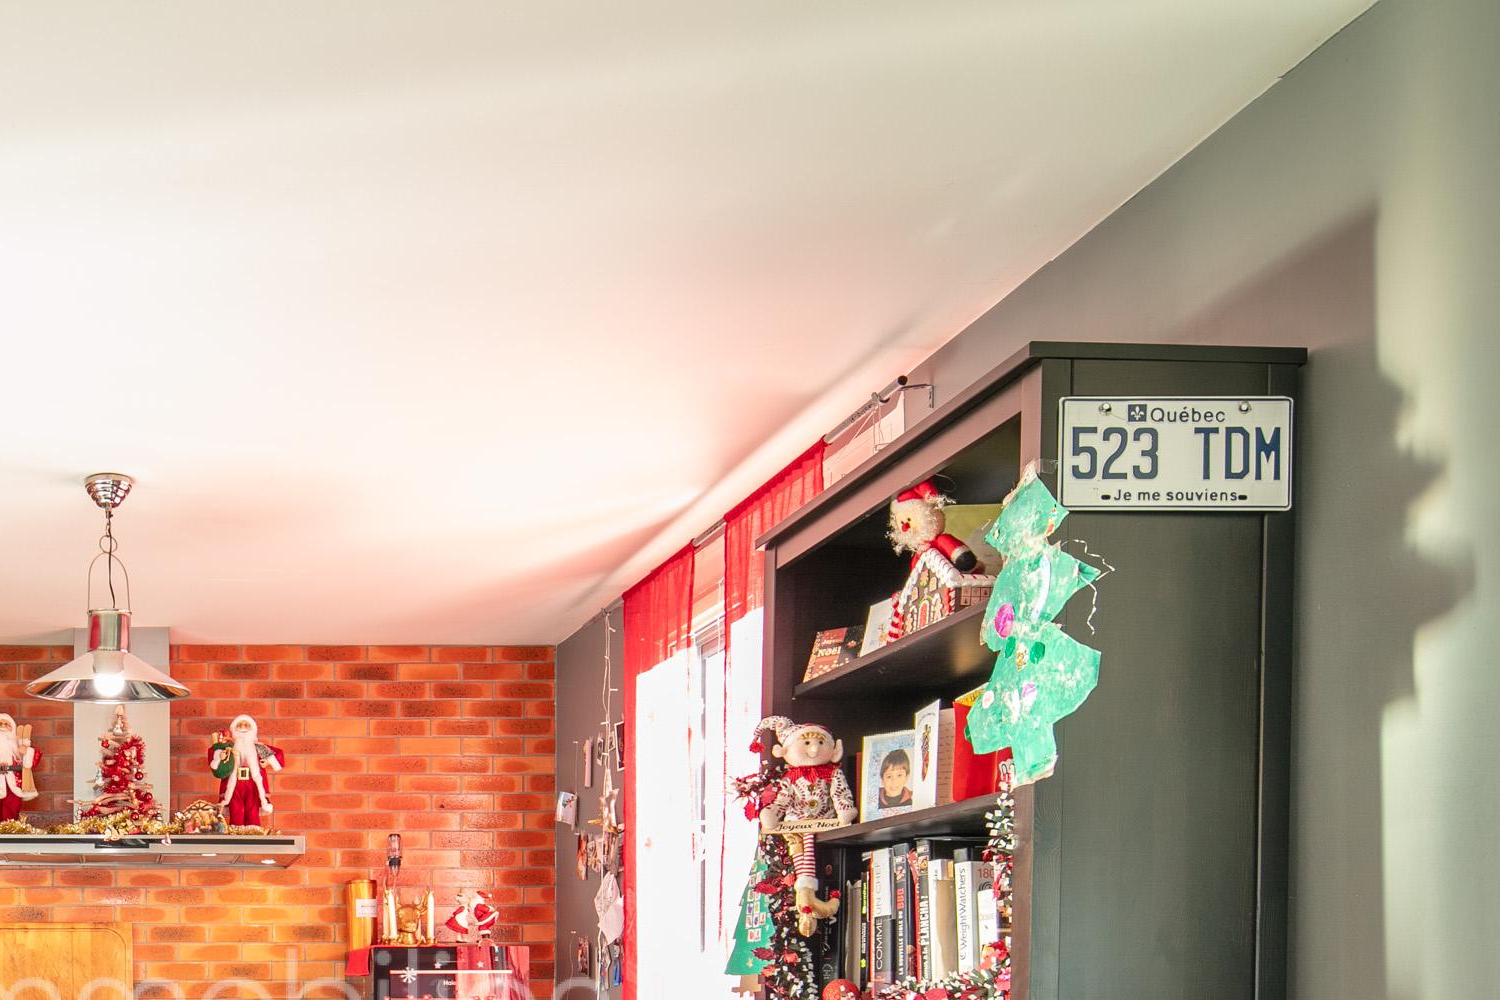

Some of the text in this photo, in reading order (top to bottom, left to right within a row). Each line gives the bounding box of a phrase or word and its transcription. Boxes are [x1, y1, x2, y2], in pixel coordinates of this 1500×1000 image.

[1150, 406, 1226, 422] Québec
[1071, 426, 1281, 481] 523 TDM
[1113, 489, 1238, 501] Je me souviens
[817, 646, 842, 657] Noël
[776, 823, 812, 832] Joyeux
[896, 888, 905, 910] BBQ
[958, 868, 971, 948] WeightWatchers
[919, 901, 930, 946] PLANCHA
[875, 918, 883, 970] COMME
